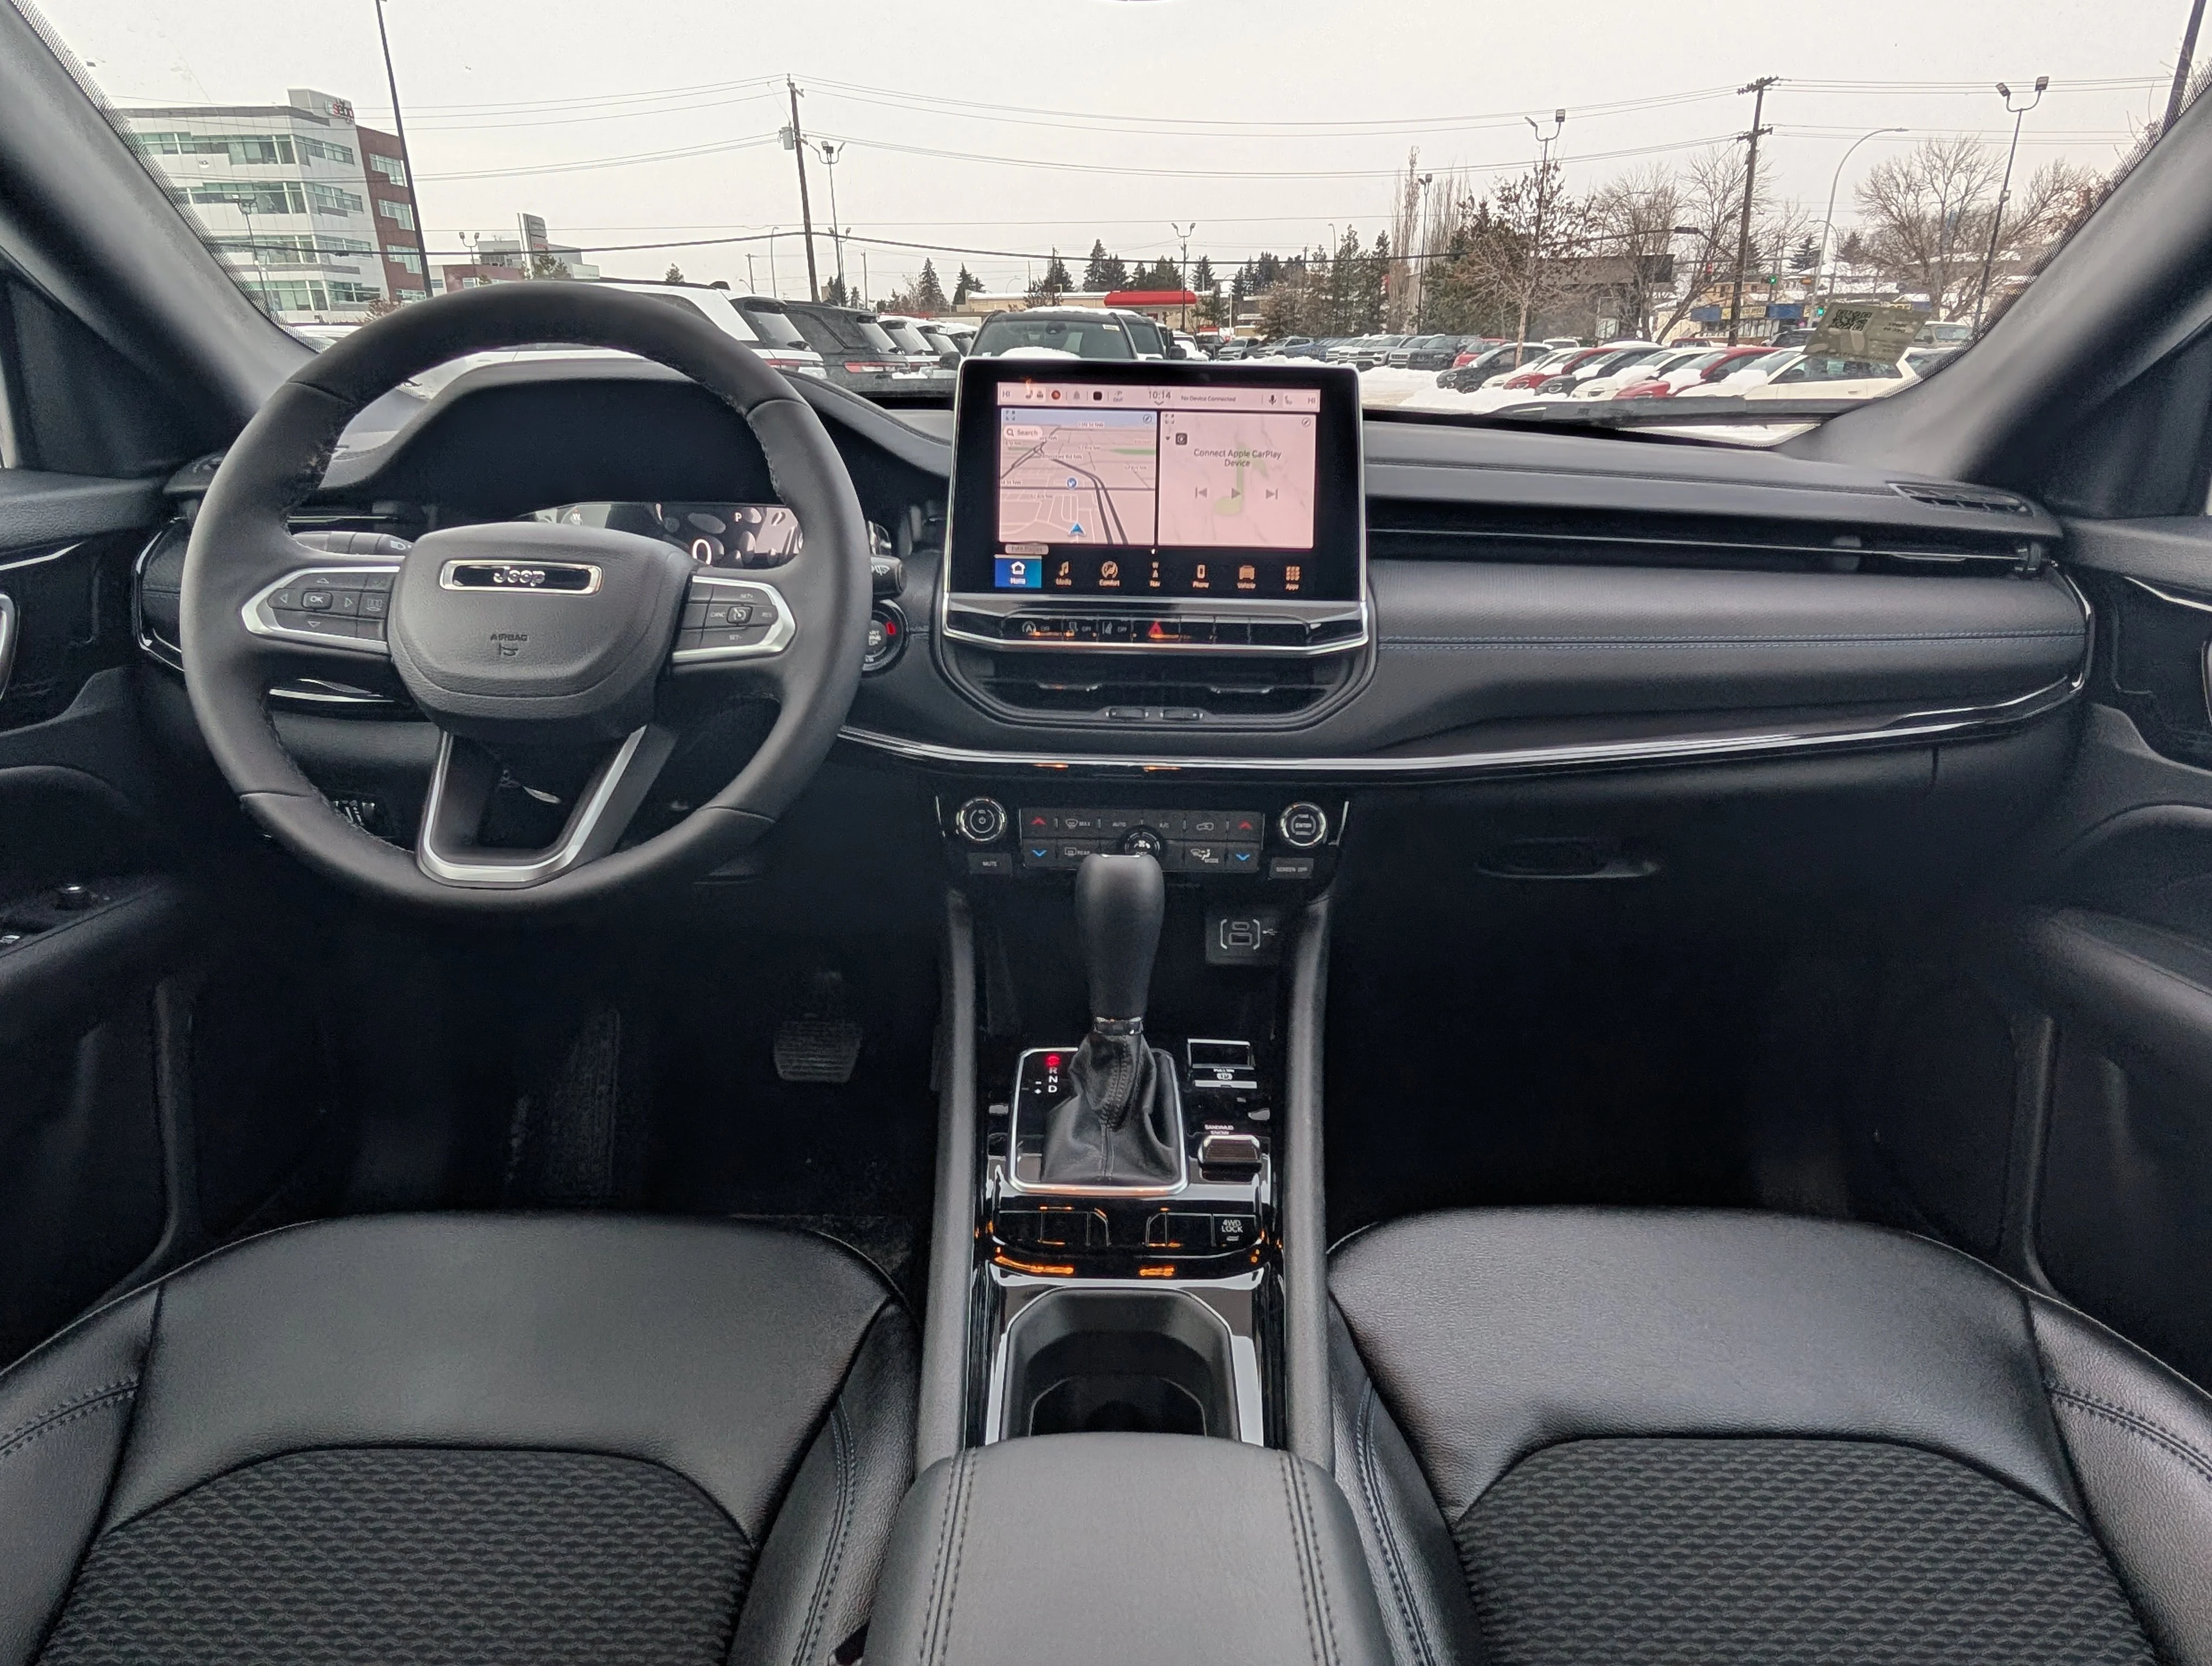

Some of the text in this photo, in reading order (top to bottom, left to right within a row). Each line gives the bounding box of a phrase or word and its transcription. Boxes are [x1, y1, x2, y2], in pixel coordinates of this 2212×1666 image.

[1148, 391, 1171, 400] 10:14
[1194, 448, 1282, 460] Connect Apple CarPlay
[1224, 459, 1250, 467] Device
[735, 512, 742, 522] P
[493, 566, 545, 586] Jeep
[1049, 1075, 1058, 1083] N
[1048, 1085, 1058, 1093] D
